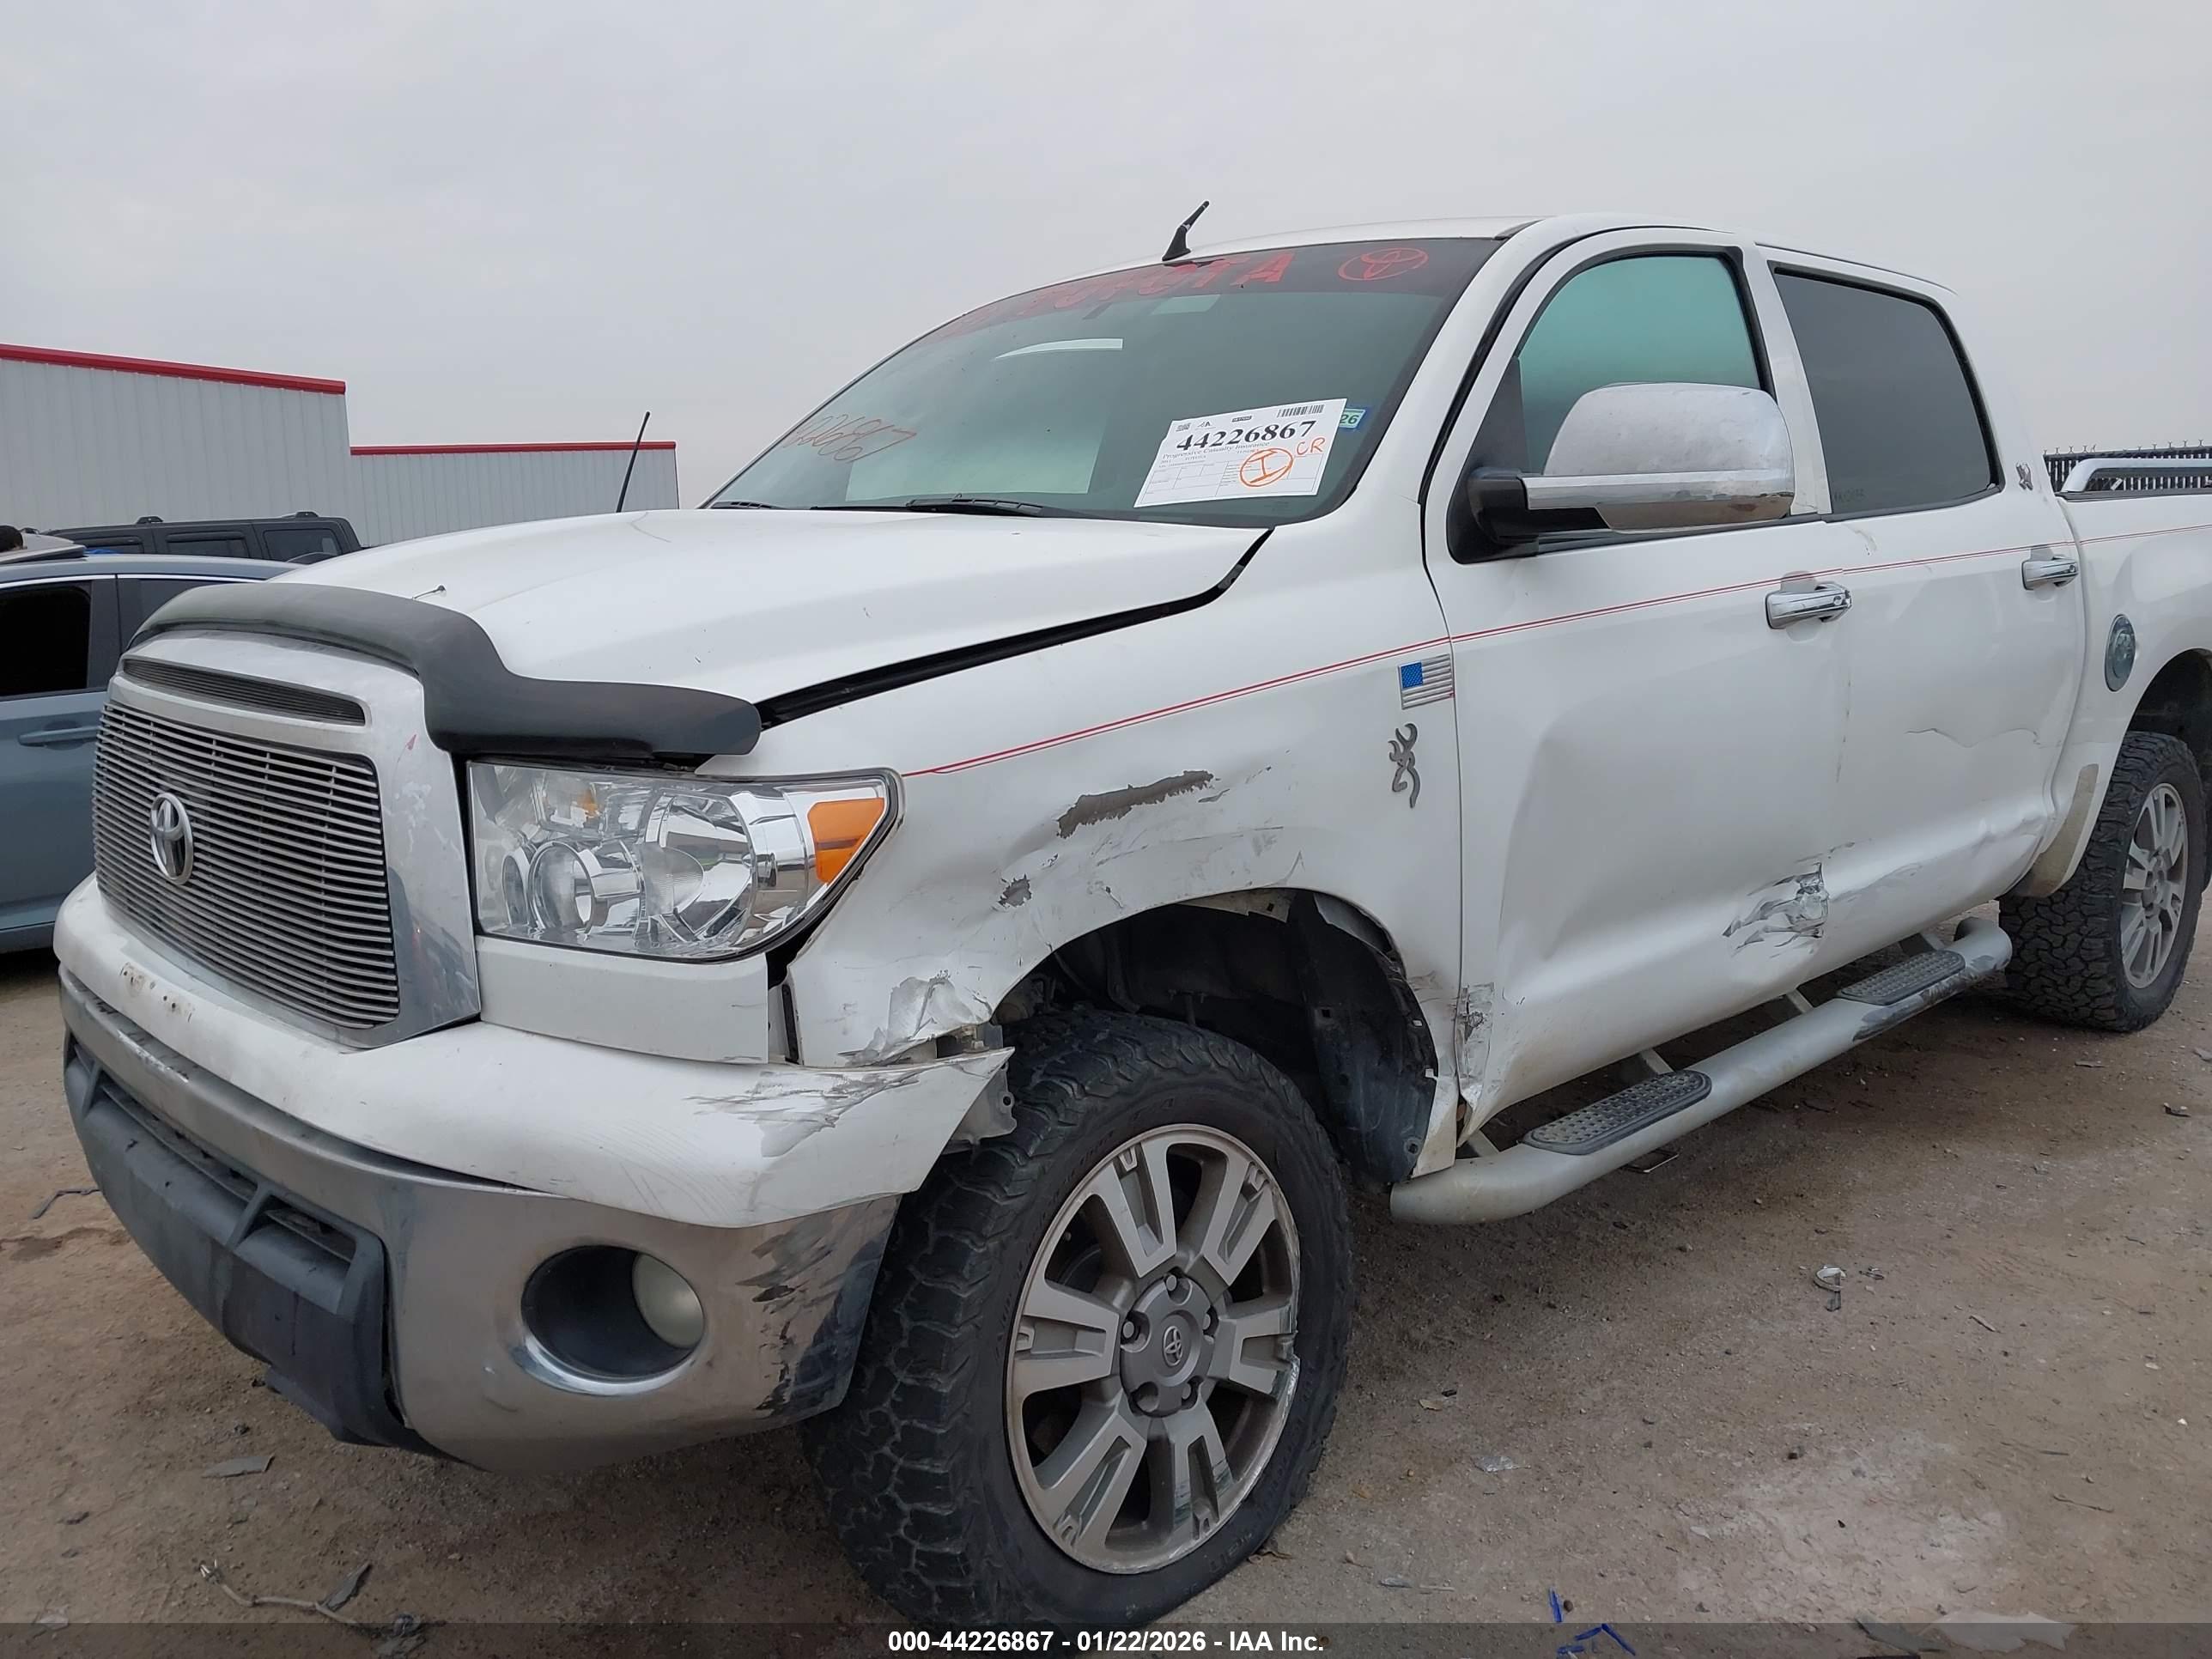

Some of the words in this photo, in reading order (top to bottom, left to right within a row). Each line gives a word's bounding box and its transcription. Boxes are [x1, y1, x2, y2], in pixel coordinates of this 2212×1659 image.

[1340, 414, 1360, 425] 26
[1176, 420, 1316, 451] 44226867
[1297, 437, 1326, 455] CR
